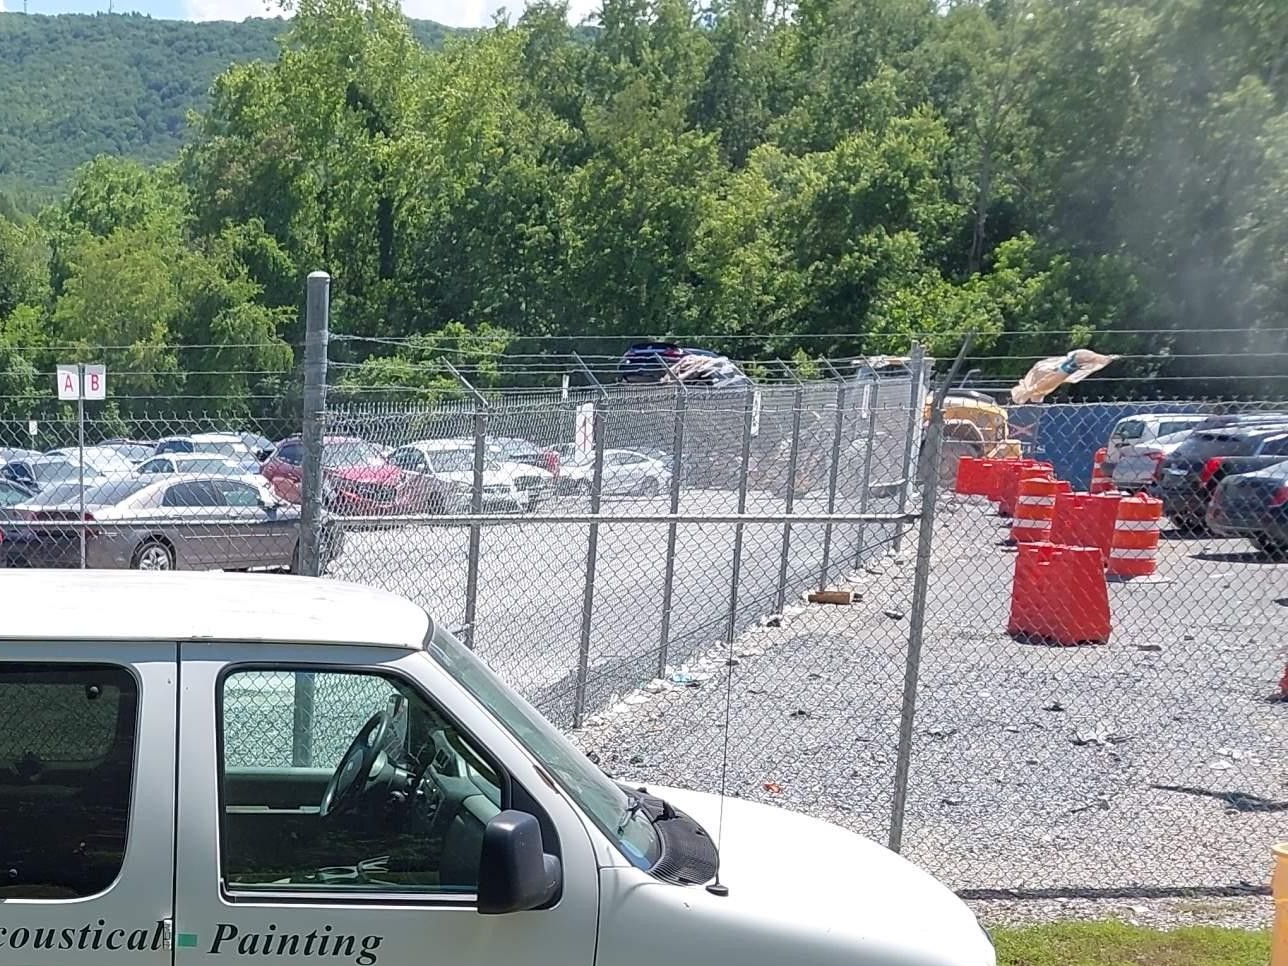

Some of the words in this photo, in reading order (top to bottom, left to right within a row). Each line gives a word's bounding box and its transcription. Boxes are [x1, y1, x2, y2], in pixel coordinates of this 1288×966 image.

[64, 375, 73, 391] A
[91, 374, 99, 391] B
[207, 923, 384, 966] Painting
